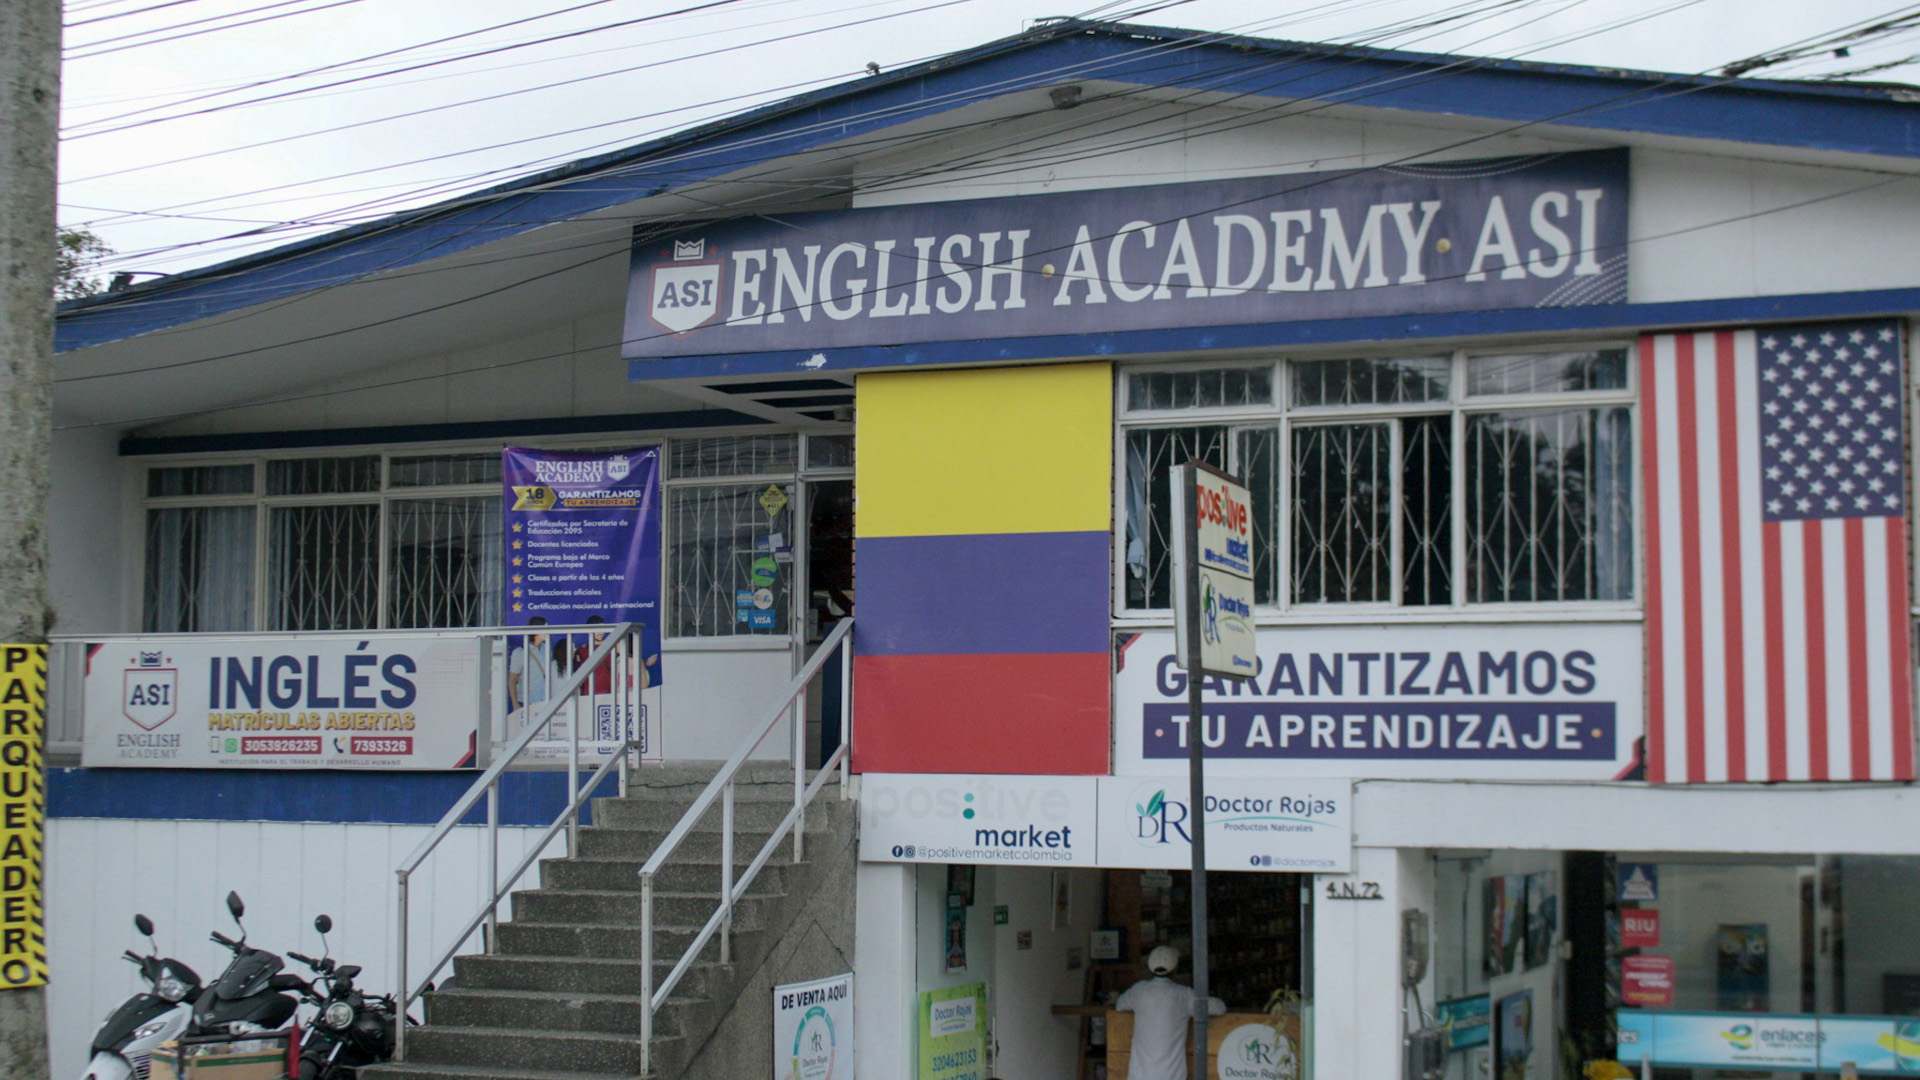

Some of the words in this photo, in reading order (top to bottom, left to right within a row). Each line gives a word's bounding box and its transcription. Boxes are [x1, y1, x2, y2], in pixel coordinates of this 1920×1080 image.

[725, 228, 1031, 328] ENGLISH
[1053, 200, 1441, 307] ACADEMY
[1464, 188, 1604, 283] ASI
[656, 277, 715, 309] ASI
[535, 460, 603, 473] ENGLISH
[610, 465, 627, 474] ASI
[534, 471, 604, 483] ACADEMY
[526, 488, 545, 499] 18
[558, 489, 642, 499] GARANTIZAMOS
[527, 520, 568, 529] Certificados
[570, 521, 582, 530] por
[583, 519, 618, 528] Secretaria
[619, 519, 629, 527] de
[527, 527, 563, 535] Educación
[564, 527, 583, 535] 2095
[561, 540, 599, 548] licenciados
[527, 554, 562, 563] Programa
[563, 554, 579, 563] bajo
[580, 553, 587, 561] el
[588, 553, 611, 561] Marco
[527, 560, 554, 569] Común
[555, 561, 584, 570] Europeo
[527, 574, 551, 582] Clases
[558, 574, 579, 583] partir
[607, 573, 625, 581] años
[527, 589, 572, 597] Traducciones
[573, 588, 602, 596] oficiales
[527, 601, 570, 610] Certificación
[572, 602, 602, 610] nacional
[609, 600, 654, 609] internacional
[753, 616, 771, 625] VISA
[208, 641, 418, 710] INGLÉS
[130, 684, 170, 706] ASI
[208, 710, 321, 732] MATRÍCULAS
[325, 712, 416, 732] ABIERTAS
[1171, 714, 1227, 748] TU
[1245, 713, 1584, 749] APRENDIZAJE
[117, 733, 181, 747] ENGLISH
[244, 739, 319, 753] 3053926235
[353, 740, 407, 753] 7393326
[117, 748, 178, 758] ACADEMY
[1203, 795, 1272, 813] Doctor
[1280, 794, 1336, 818] Rojas
[1, 647, 31, 985] PARQUEADERO
[1137, 801, 1192, 844] DR
[1223, 823, 1268, 832] Productos
[1270, 824, 1314, 833] Naturales
[975, 825, 1071, 848] market
[918, 846, 1072, 861] @positivemarketcolombia
[1624, 918, 1656, 933] RIU
[781, 993, 794, 1010] DE
[797, 988, 825, 1007] VENTA
[827, 980, 847, 1001] AQUÍ
[935, 1007, 954, 1020] Doctor
[956, 1005, 973, 1018] Rojas
[1760, 1028, 1826, 1043] enlaces
[1225, 1066, 1257, 1078] Doctor
